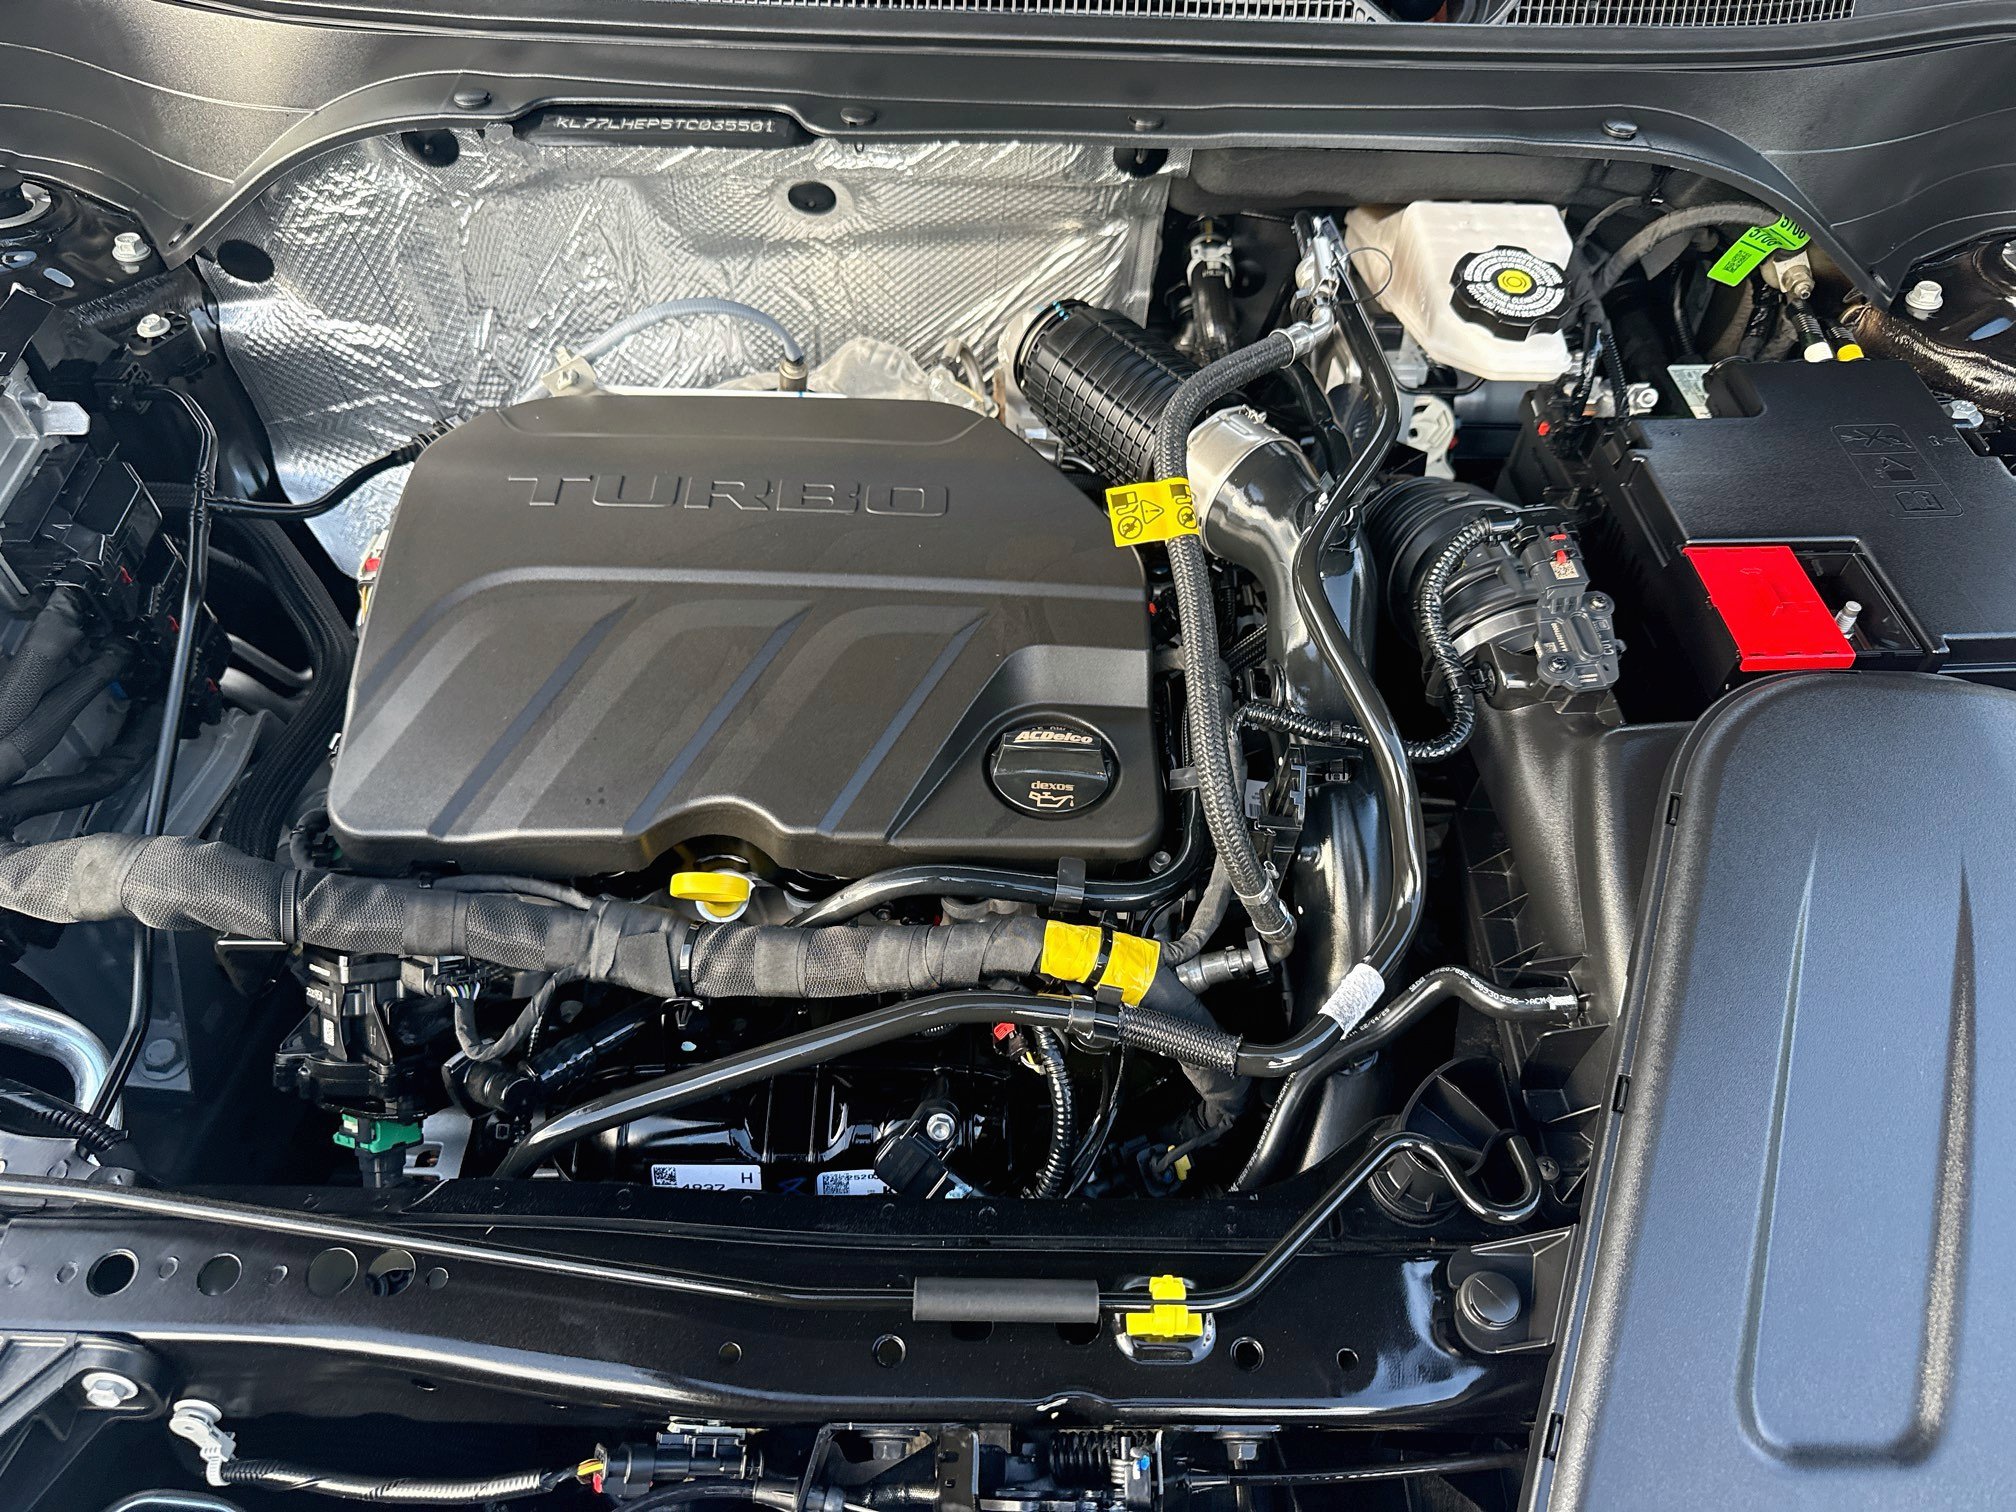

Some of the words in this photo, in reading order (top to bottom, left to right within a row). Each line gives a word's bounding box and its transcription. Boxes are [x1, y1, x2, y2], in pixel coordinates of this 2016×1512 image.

[555, 116, 775, 132] KL77LHEP5TC035501
[507, 475, 948, 517] TURBO
[1014, 730, 1094, 744] ACDelco
[1031, 781, 1075, 791] dexos
[740, 1172, 753, 1184] H
